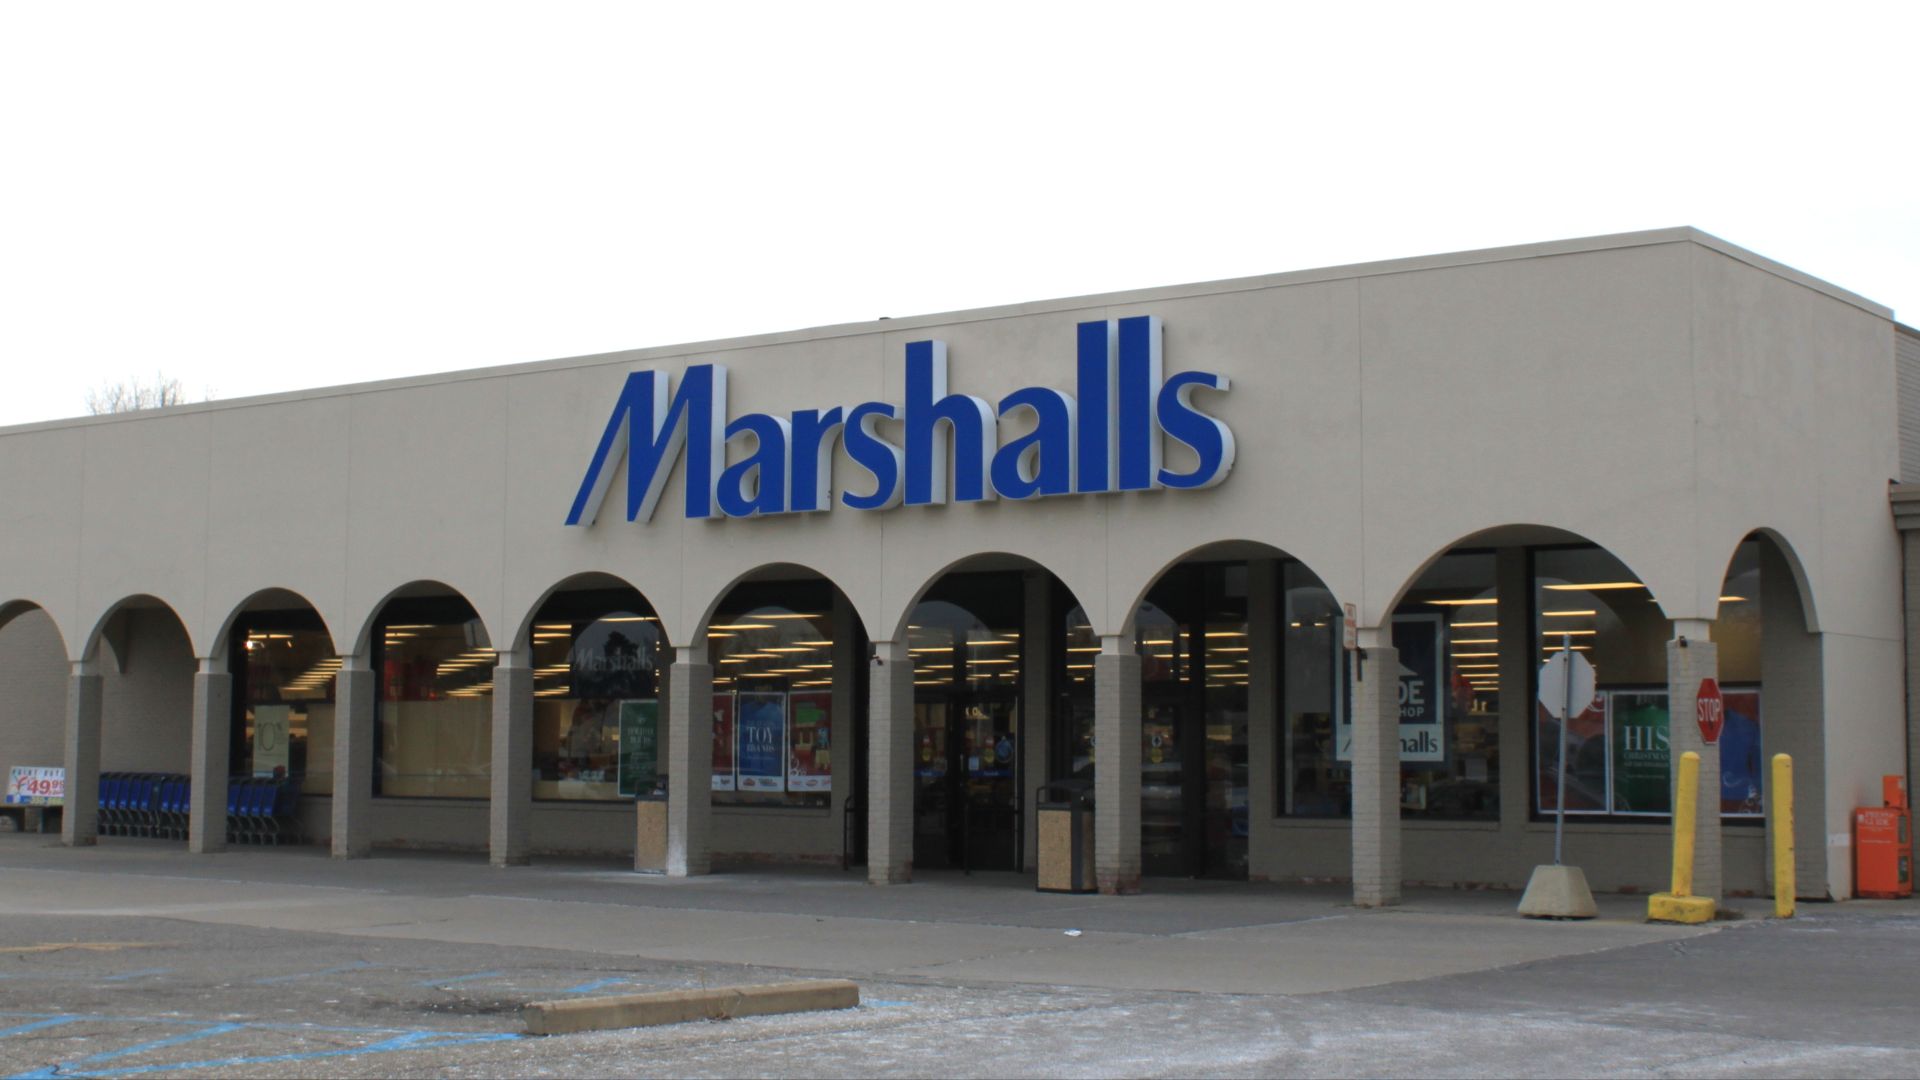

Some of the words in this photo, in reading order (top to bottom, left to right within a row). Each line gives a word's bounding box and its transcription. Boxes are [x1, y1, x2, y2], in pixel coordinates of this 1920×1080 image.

[565, 315, 1235, 526] Marshalls
[1698, 698, 1720, 721] STOP
[746, 726, 773, 744] TOY
[1623, 725, 1670, 751] HIS
